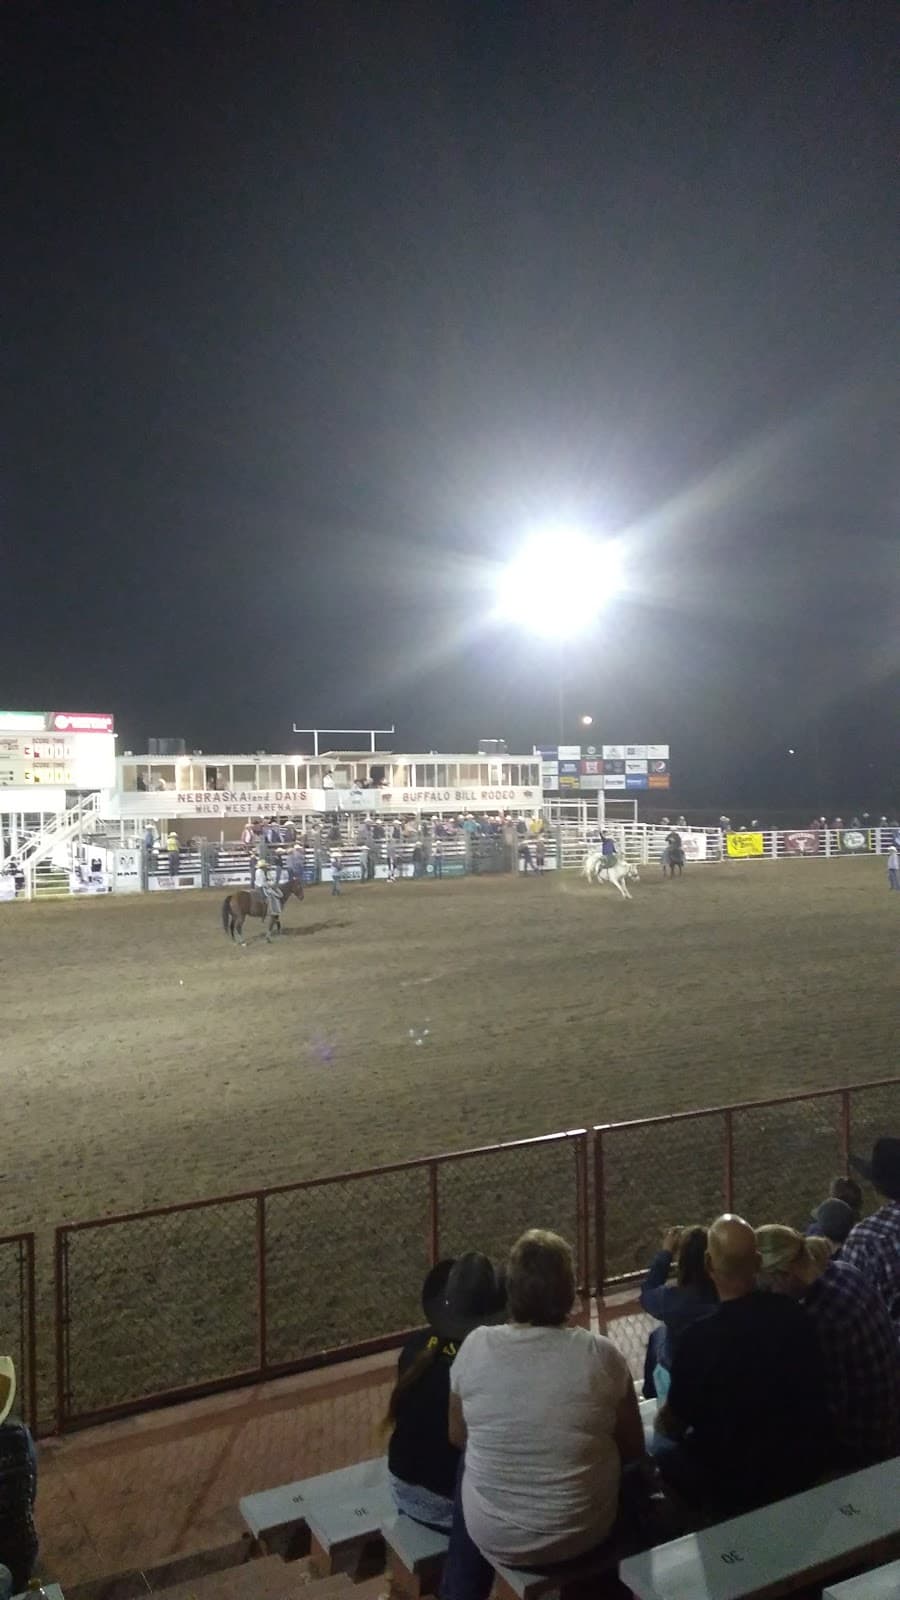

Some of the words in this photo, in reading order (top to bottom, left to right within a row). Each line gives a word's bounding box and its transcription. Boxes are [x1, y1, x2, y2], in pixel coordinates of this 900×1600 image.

[275, 791, 308, 801] DAYS
[402, 791, 450, 802] BUFFALO
[455, 791, 477, 801] BILL
[481, 790, 516, 800] RODEO
[195, 804, 219, 813] WILD
[226, 803, 252, 813] WEST
[257, 803, 291, 812] ARENA
